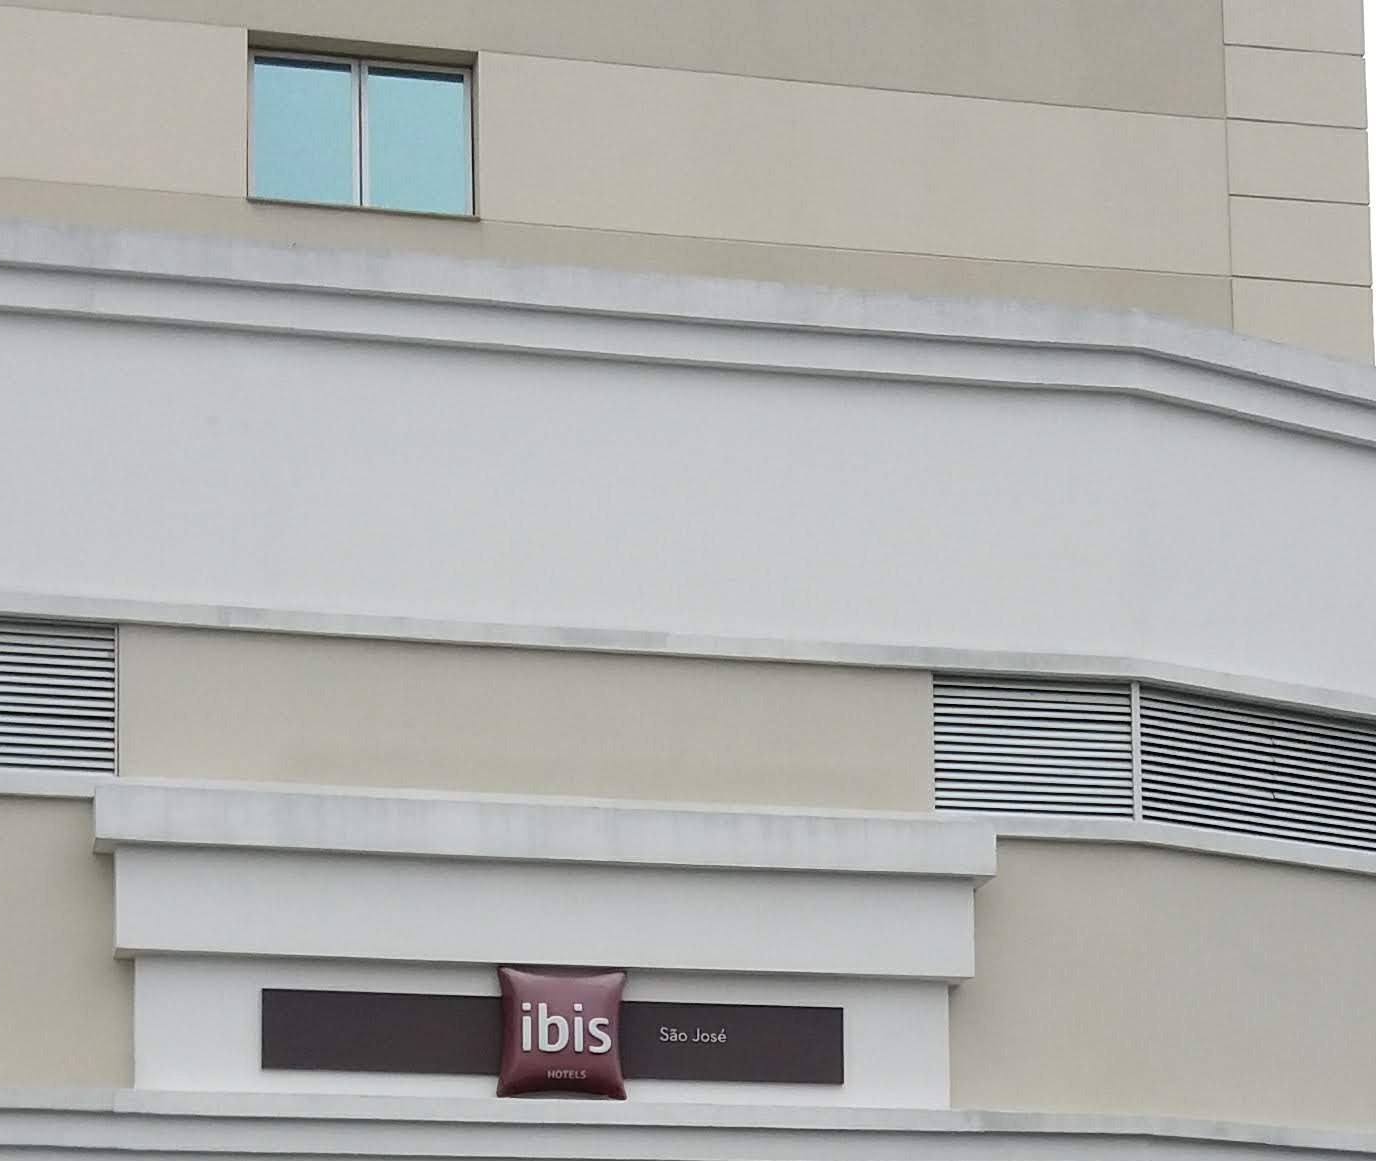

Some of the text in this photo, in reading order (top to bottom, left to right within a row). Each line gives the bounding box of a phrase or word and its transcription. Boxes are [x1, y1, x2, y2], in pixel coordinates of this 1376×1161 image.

[522, 1002, 612, 1054] ibis
[660, 1027, 727, 1043] São José
[547, 1069, 587, 1080] HOTELS
